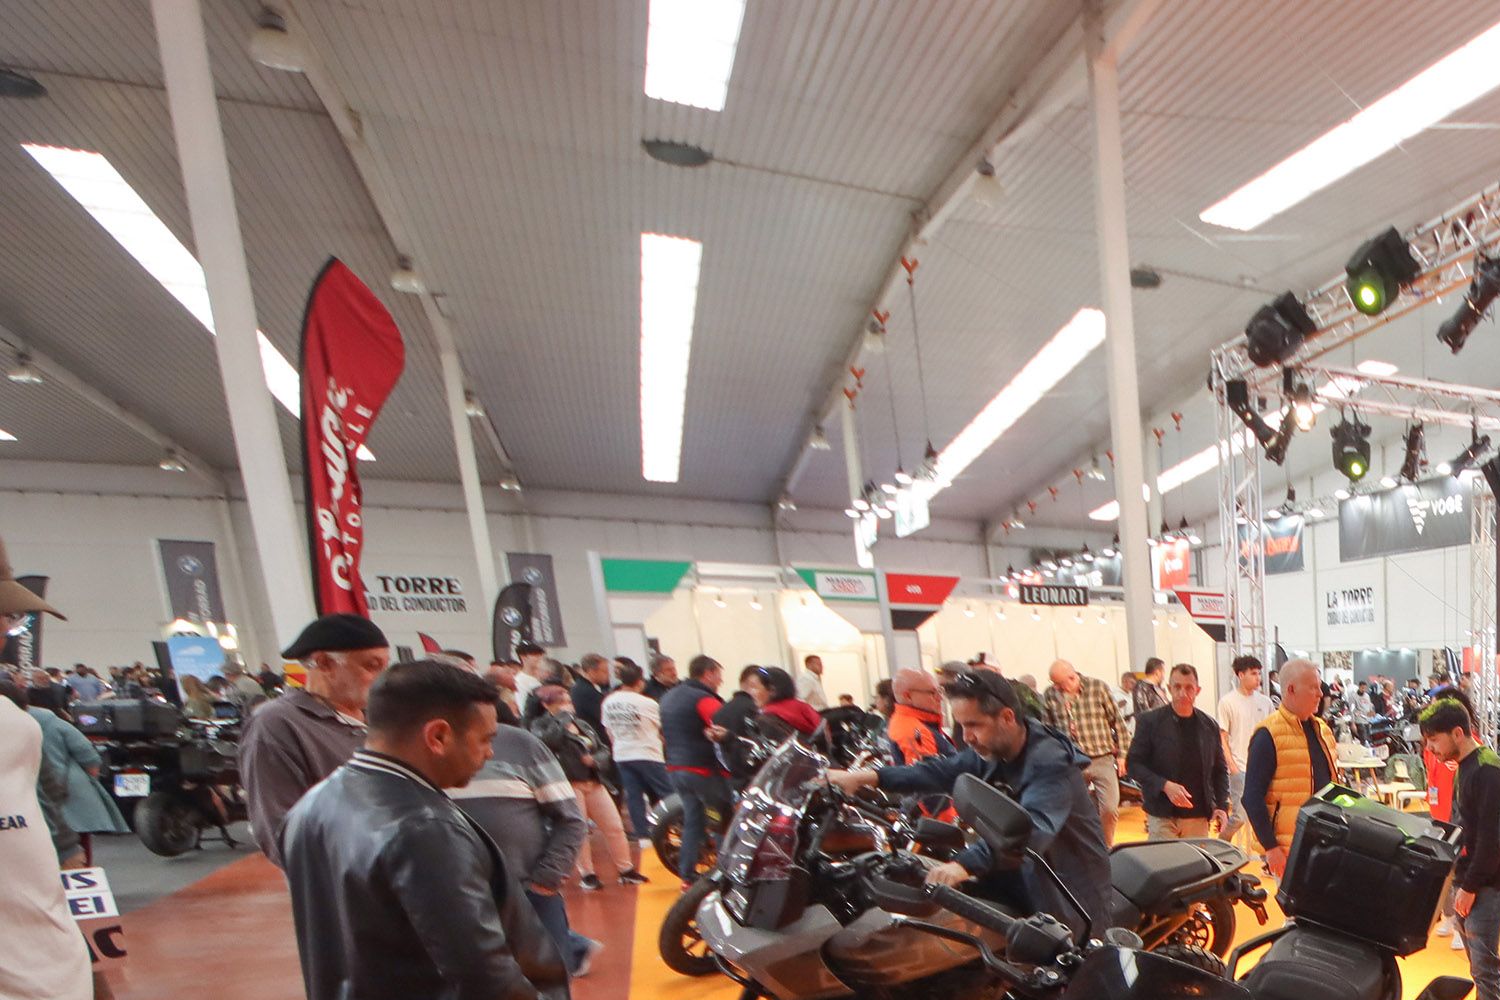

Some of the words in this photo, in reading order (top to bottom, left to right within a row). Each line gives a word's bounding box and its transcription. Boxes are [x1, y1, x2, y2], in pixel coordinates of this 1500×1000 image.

[1430, 494, 1463, 516] VOGE
[376, 575, 464, 595] TORRE
[1023, 585, 1085, 605] LEONART
